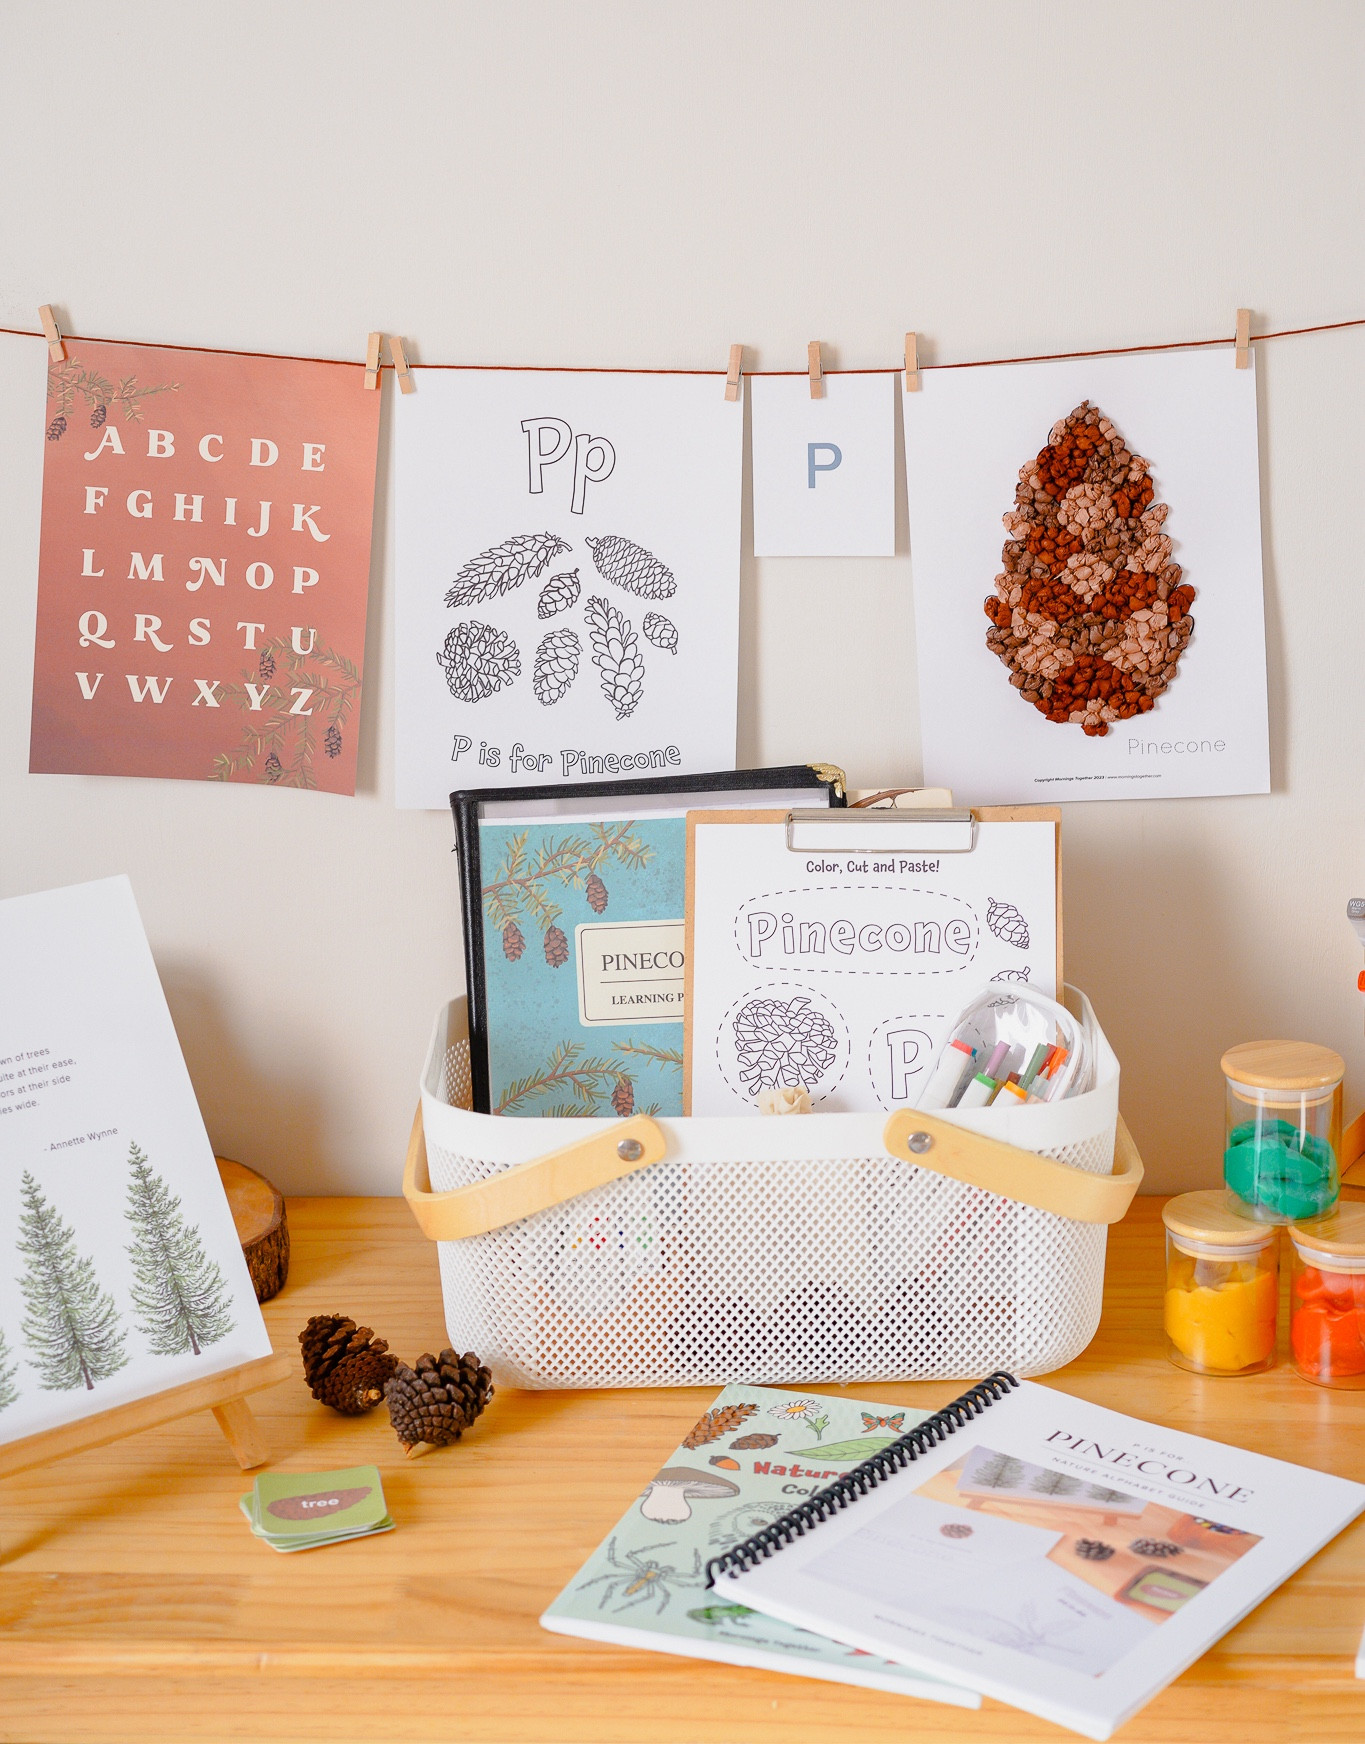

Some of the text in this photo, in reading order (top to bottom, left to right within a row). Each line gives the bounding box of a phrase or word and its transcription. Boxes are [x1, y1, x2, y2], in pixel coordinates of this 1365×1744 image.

[520, 417, 616, 514] Pp
[806, 442, 843, 489] P
[451, 735, 682, 776] P is for Pinecone
[1128, 738, 1227, 755] Pinecone
[806, 859, 940, 874] Color, Cut and Paste!
[747, 911, 972, 958] Pinecone
[601, 951, 685, 971] PINECO
[611, 993, 674, 1005] LEARNING
[15, 1052, 25, 1061] of
[26, 1047, 50, 1059] trees
[886, 1029, 934, 1099] P
[17, 1069, 27, 1078] at
[28, 1063, 49, 1075] their
[52, 1057, 77, 1069] ease,
[17, 1085, 27, 1094] at
[28, 1080, 49, 1091] their
[52, 1074, 71, 1086] side
[50, 1135, 85, 1151] Annette
[86, 1127, 118, 1141] Wynne
[1045, 1430, 1255, 1504] PINECONE
[1052, 1457, 1206, 1509] NATURE ALPHABET GUIDE
[301, 1498, 340, 1509] tree
